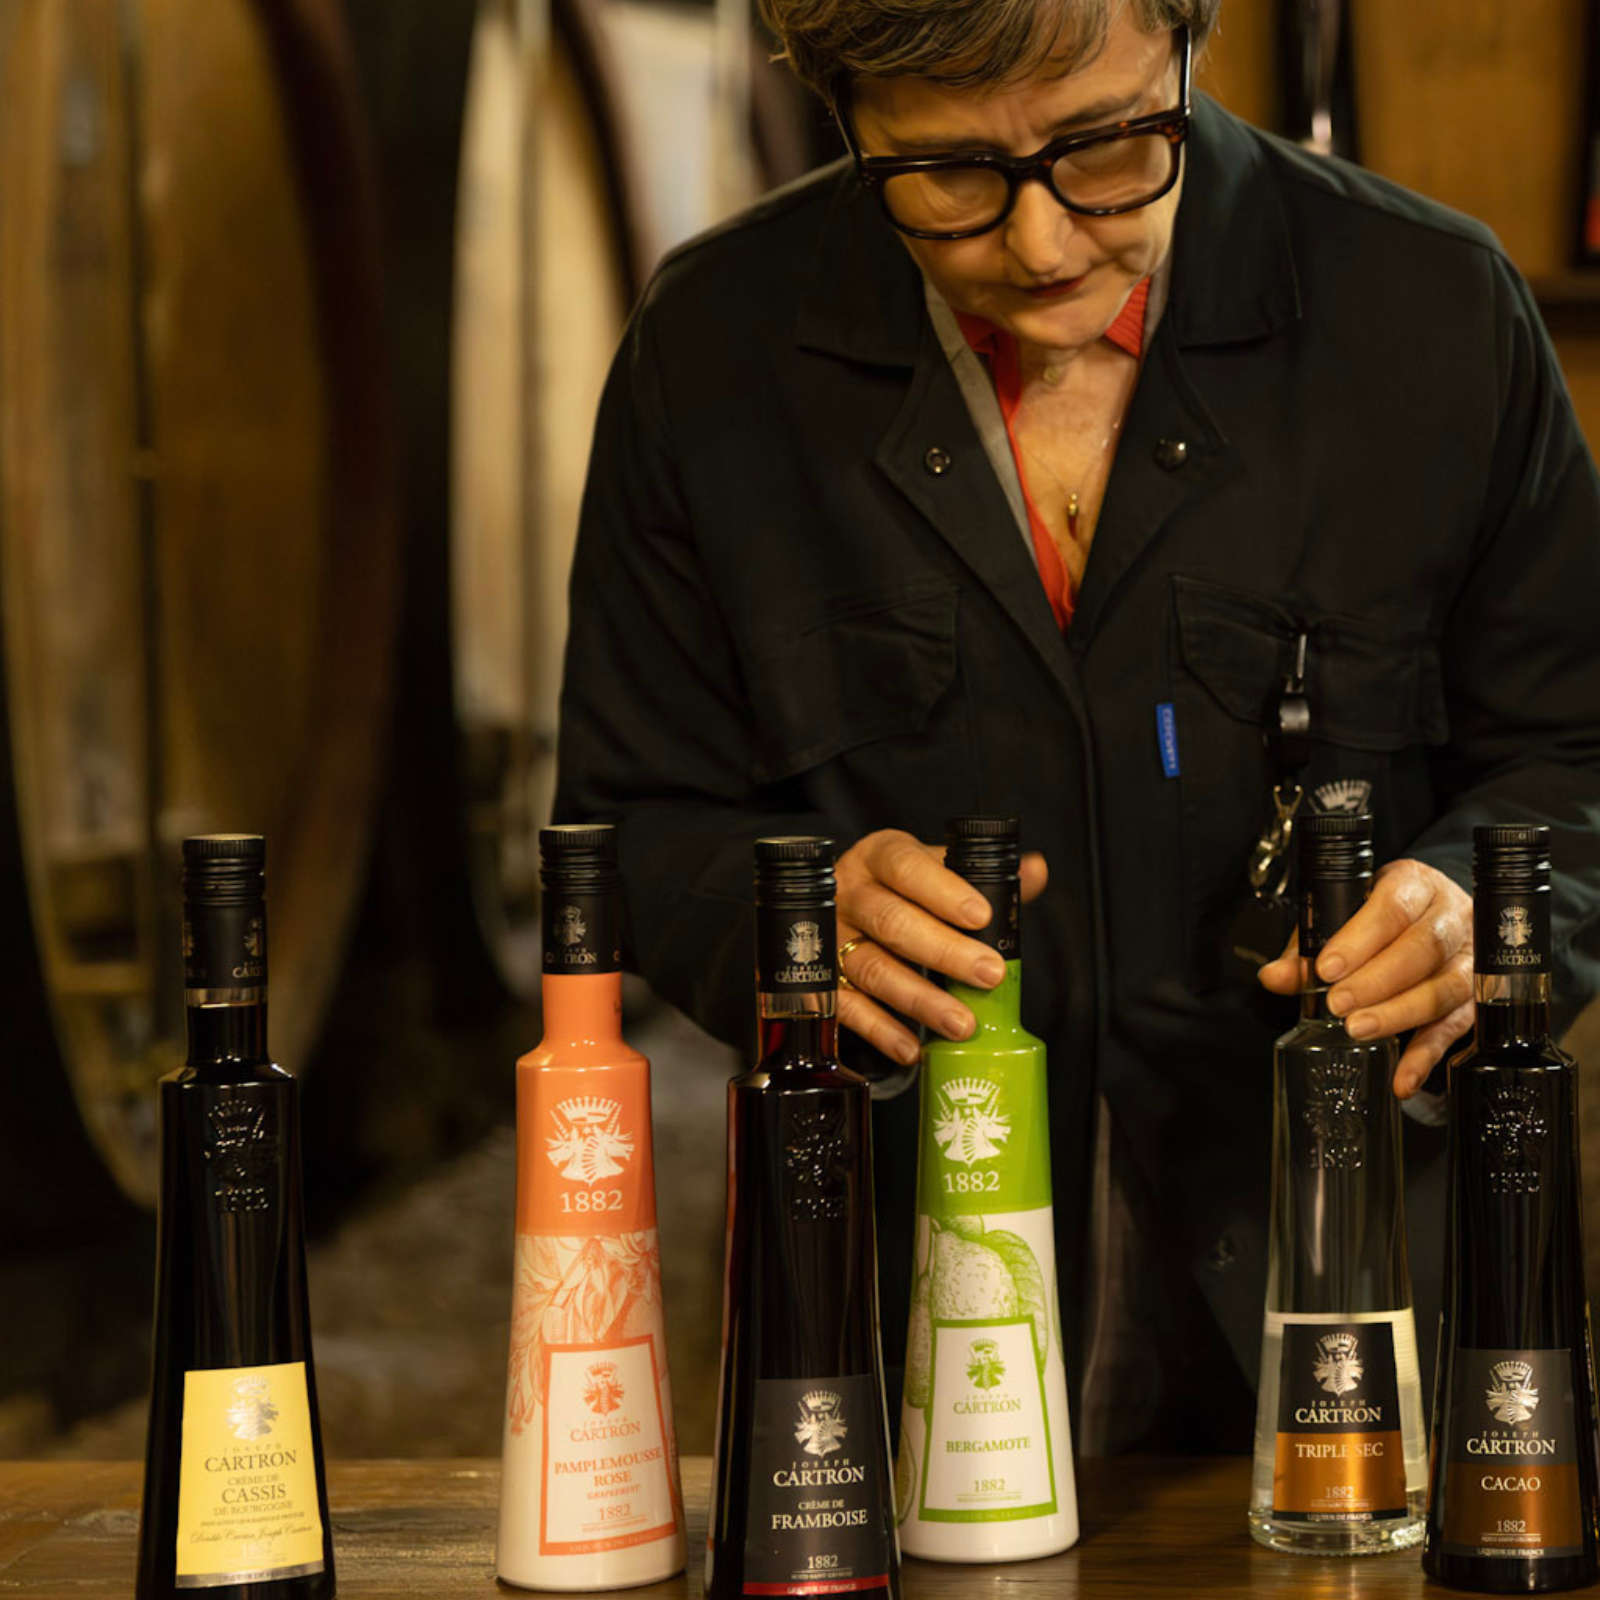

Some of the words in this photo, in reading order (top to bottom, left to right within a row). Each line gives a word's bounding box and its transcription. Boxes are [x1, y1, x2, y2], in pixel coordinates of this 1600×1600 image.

[775, 969, 832, 983] CARTRON
[943, 1170, 1000, 1193] 1882
[560, 1189, 624, 1213] 1882
[953, 1398, 1022, 1415] CARTRON
[1311, 1400, 1366, 1408] JOSEPH
[1295, 1407, 1382, 1424] CARTRON
[570, 1421, 641, 1443] CARTRON
[1483, 1430, 1539, 1438] JOSEPH
[946, 1436, 1031, 1453] BERGAMOTE
[1295, 1443, 1349, 1459] TRIPLE
[1354, 1442, 1384, 1457] SEC
[1466, 1439, 1555, 1455] CARTRON
[204, 1450, 298, 1472] CARTRON
[554, 1446, 662, 1475] PAMPLEMOUSSE
[792, 1459, 850, 1469] JOSEPH
[266, 1474, 279, 1484] DE
[593, 1471, 632, 1487] ROSE
[773, 1466, 865, 1487] CARTRON
[1481, 1476, 1542, 1492] CACAO
[974, 1479, 1006, 1492] 1882
[1325, 1486, 1355, 1499] 1882
[221, 1484, 287, 1504] CASSIS
[214, 1505, 229, 1517] DE
[233, 1501, 294, 1515] BOURGOGNE
[599, 1504, 632, 1521] 1882
[798, 1499, 830, 1511] CRÈME
[832, 1499, 844, 1509] DE
[771, 1509, 868, 1530] FRAMBOISE
[1496, 1520, 1526, 1533] 1882
[807, 1555, 838, 1570] 1882
